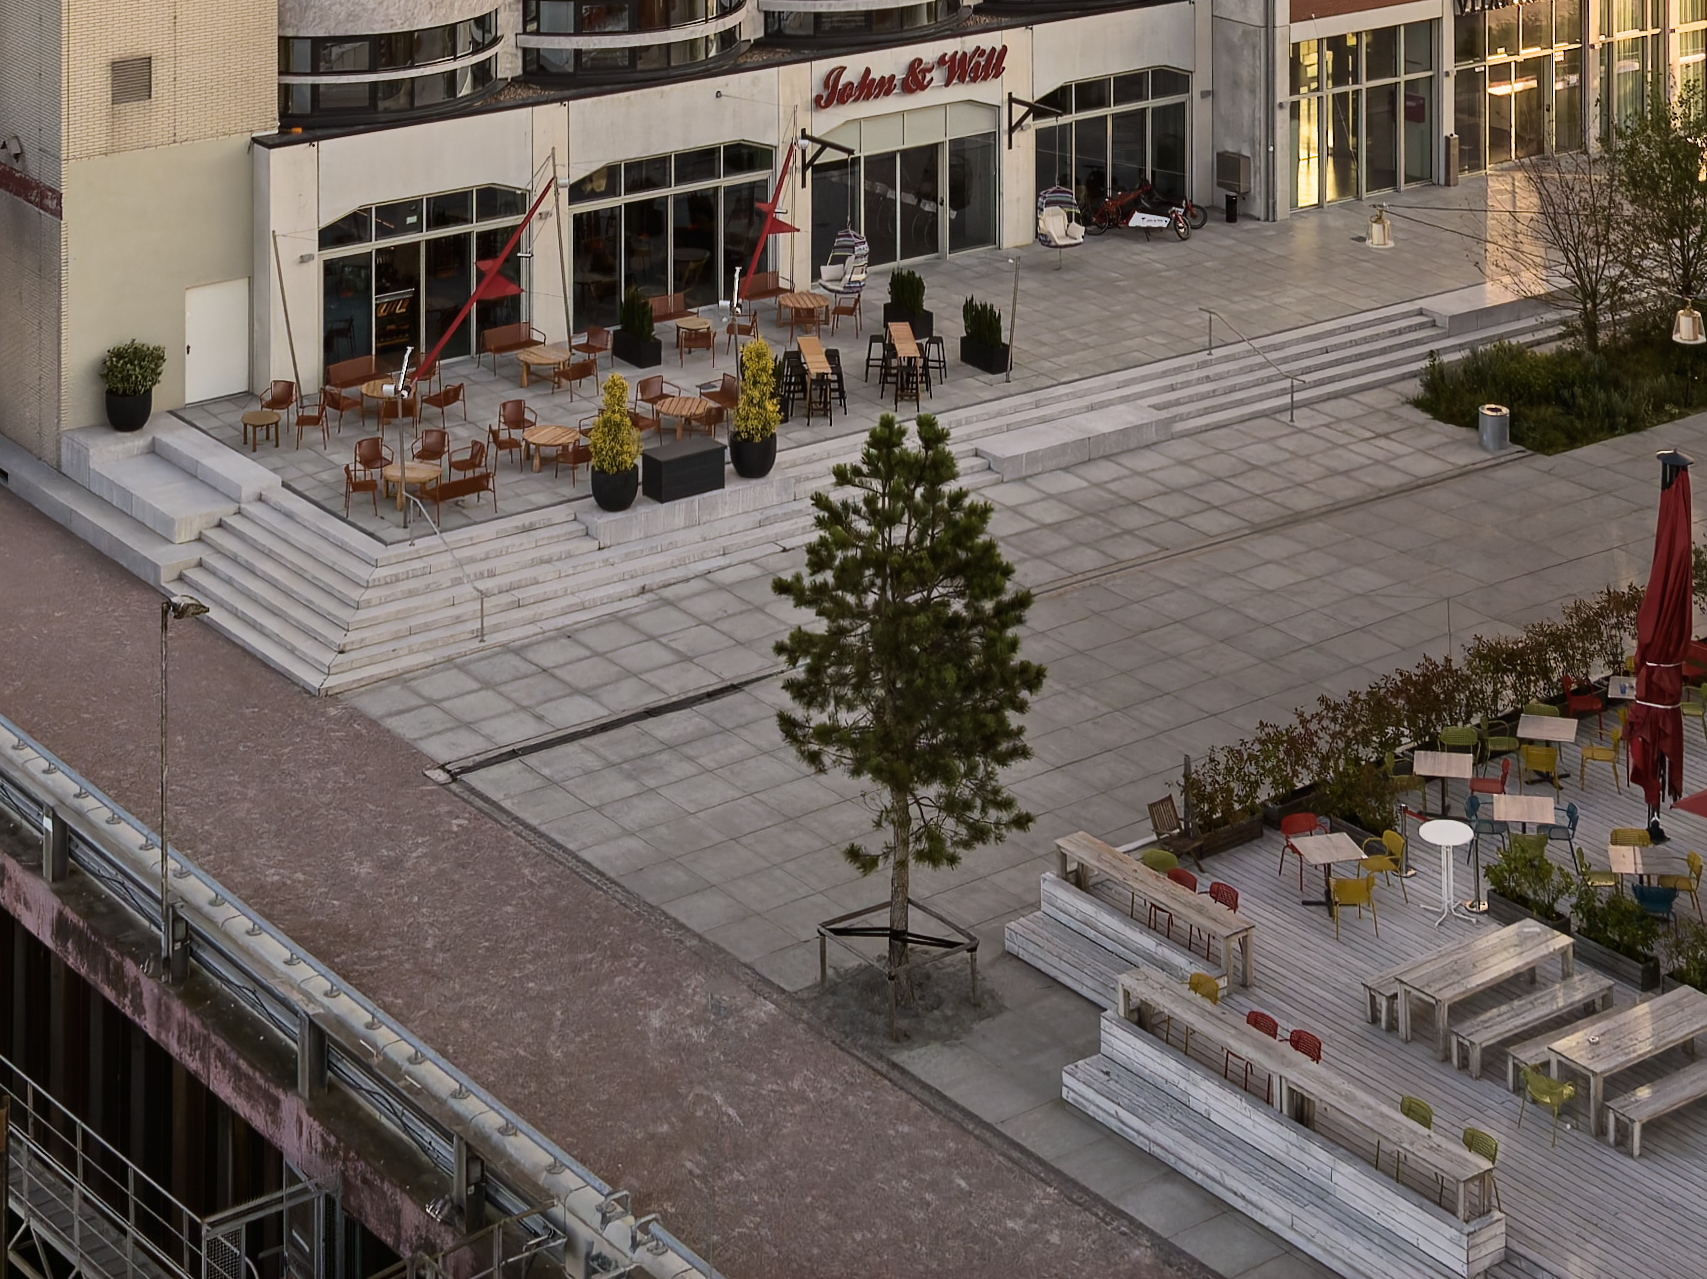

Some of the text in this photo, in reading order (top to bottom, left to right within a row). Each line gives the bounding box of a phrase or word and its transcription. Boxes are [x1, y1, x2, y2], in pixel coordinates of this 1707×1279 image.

[815, 44, 1008, 110] John & Will
